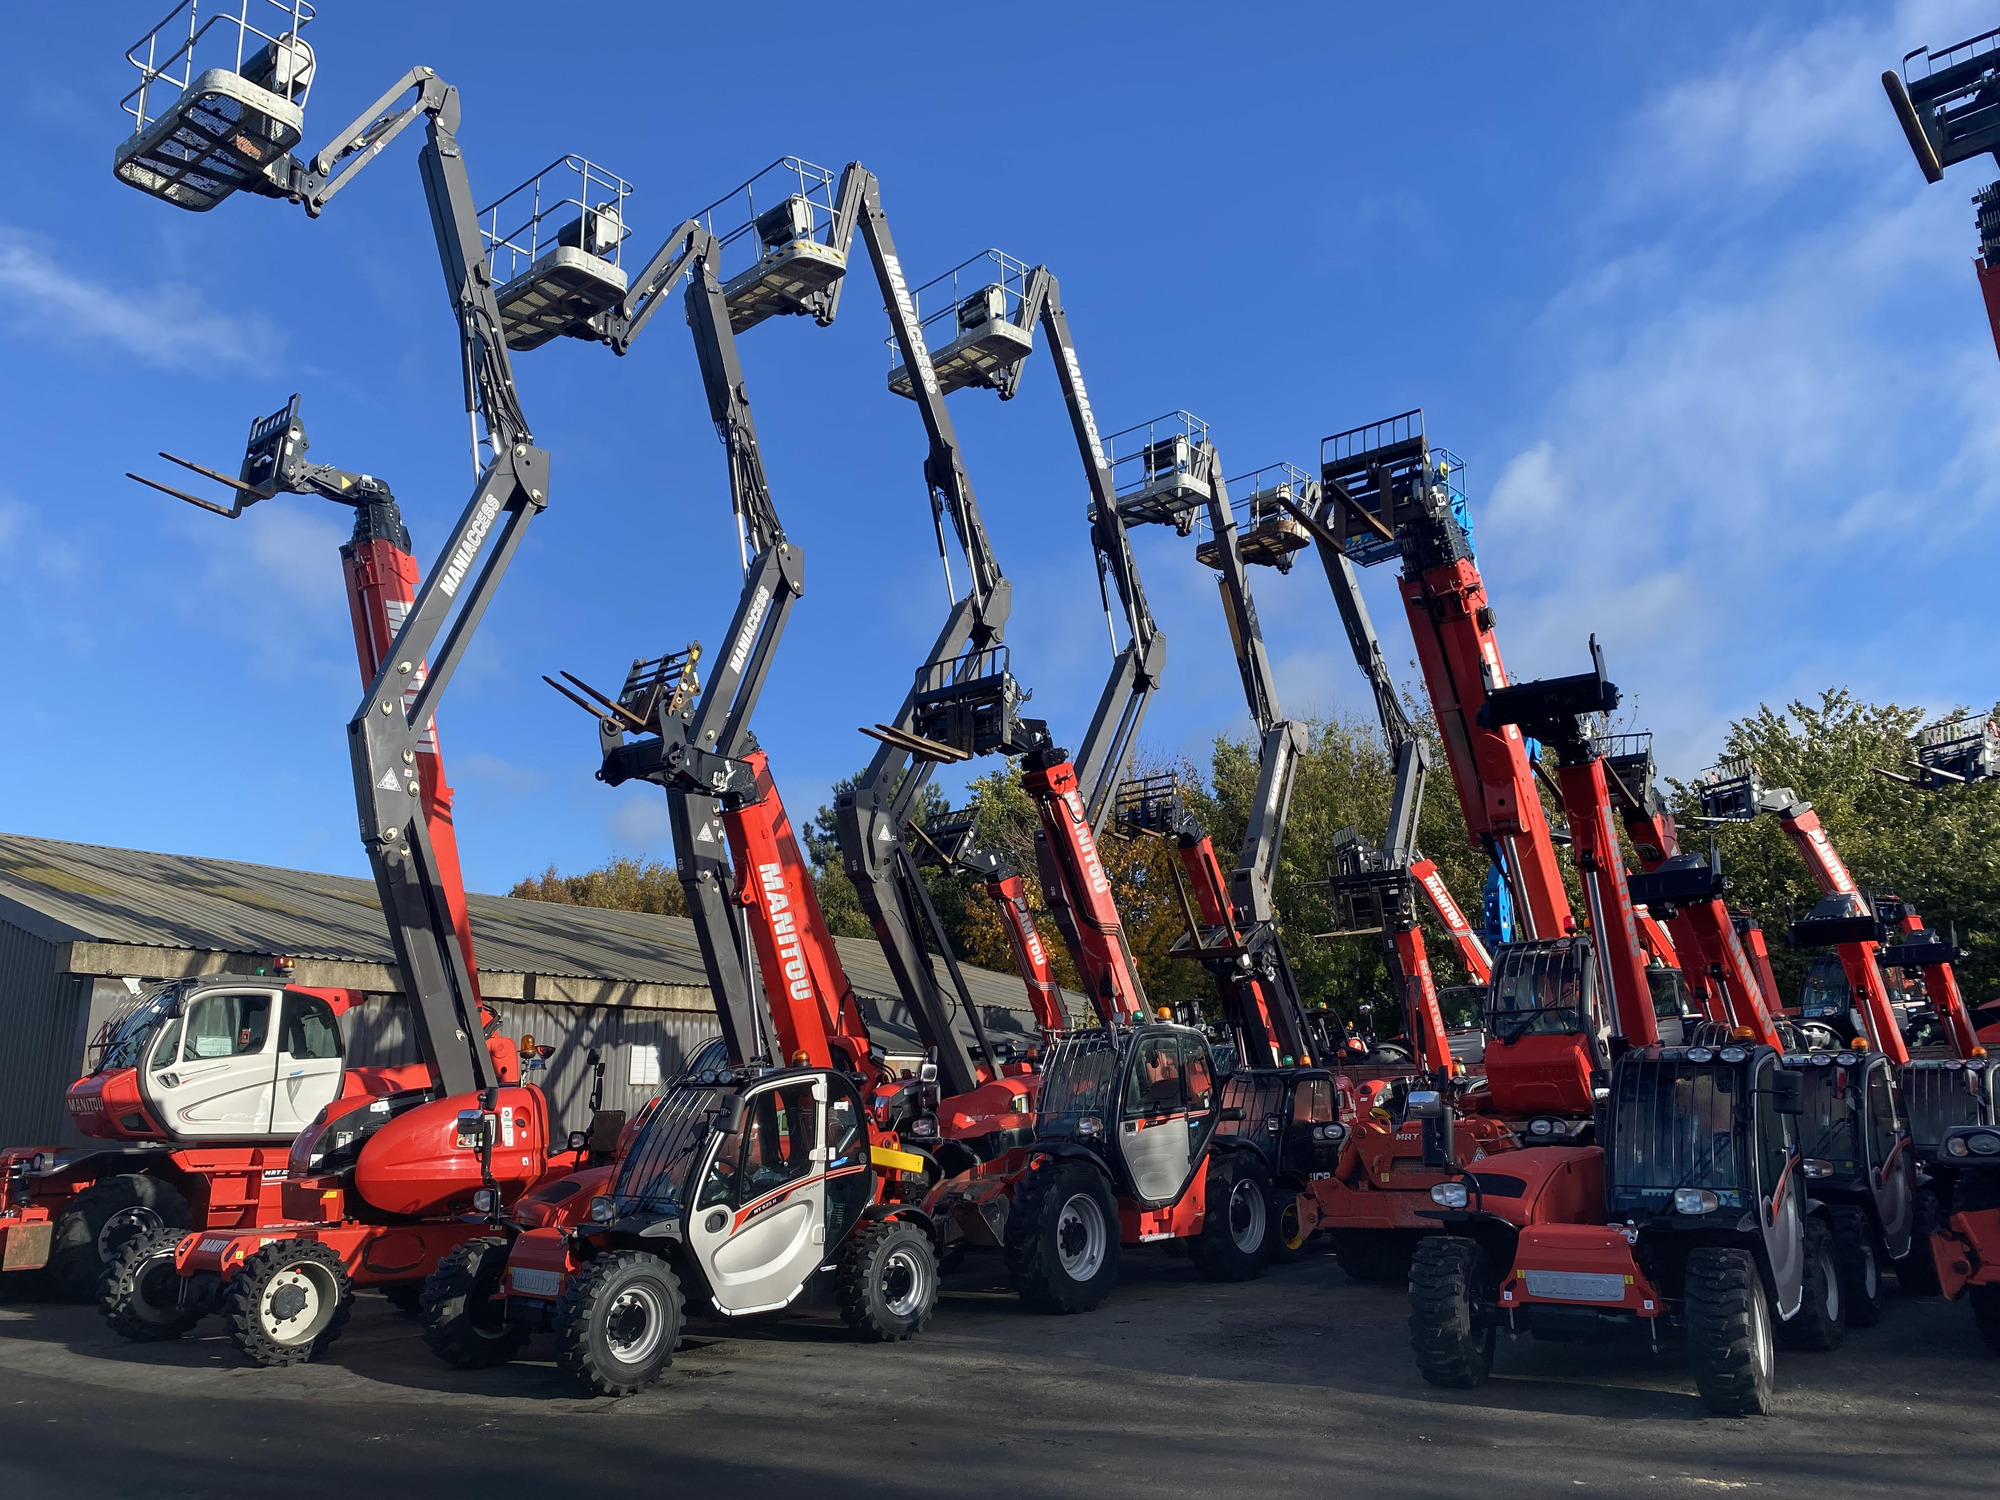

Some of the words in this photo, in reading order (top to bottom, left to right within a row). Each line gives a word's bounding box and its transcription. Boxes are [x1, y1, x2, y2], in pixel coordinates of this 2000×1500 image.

[882, 253, 938, 395] MANIACCESS
[1063, 346, 1108, 470] MANIACCESS
[439, 493, 500, 598] MANIACCESS
[729, 585, 770, 675] MANIACCESS
[758, 862, 812, 1001] MANITOU
[1014, 896, 1046, 966] MANITOU
[1424, 875, 1464, 929] MANITOU
[68, 1097, 104, 1112] MANITOU
[1396, 1133, 1419, 1141] MRT
